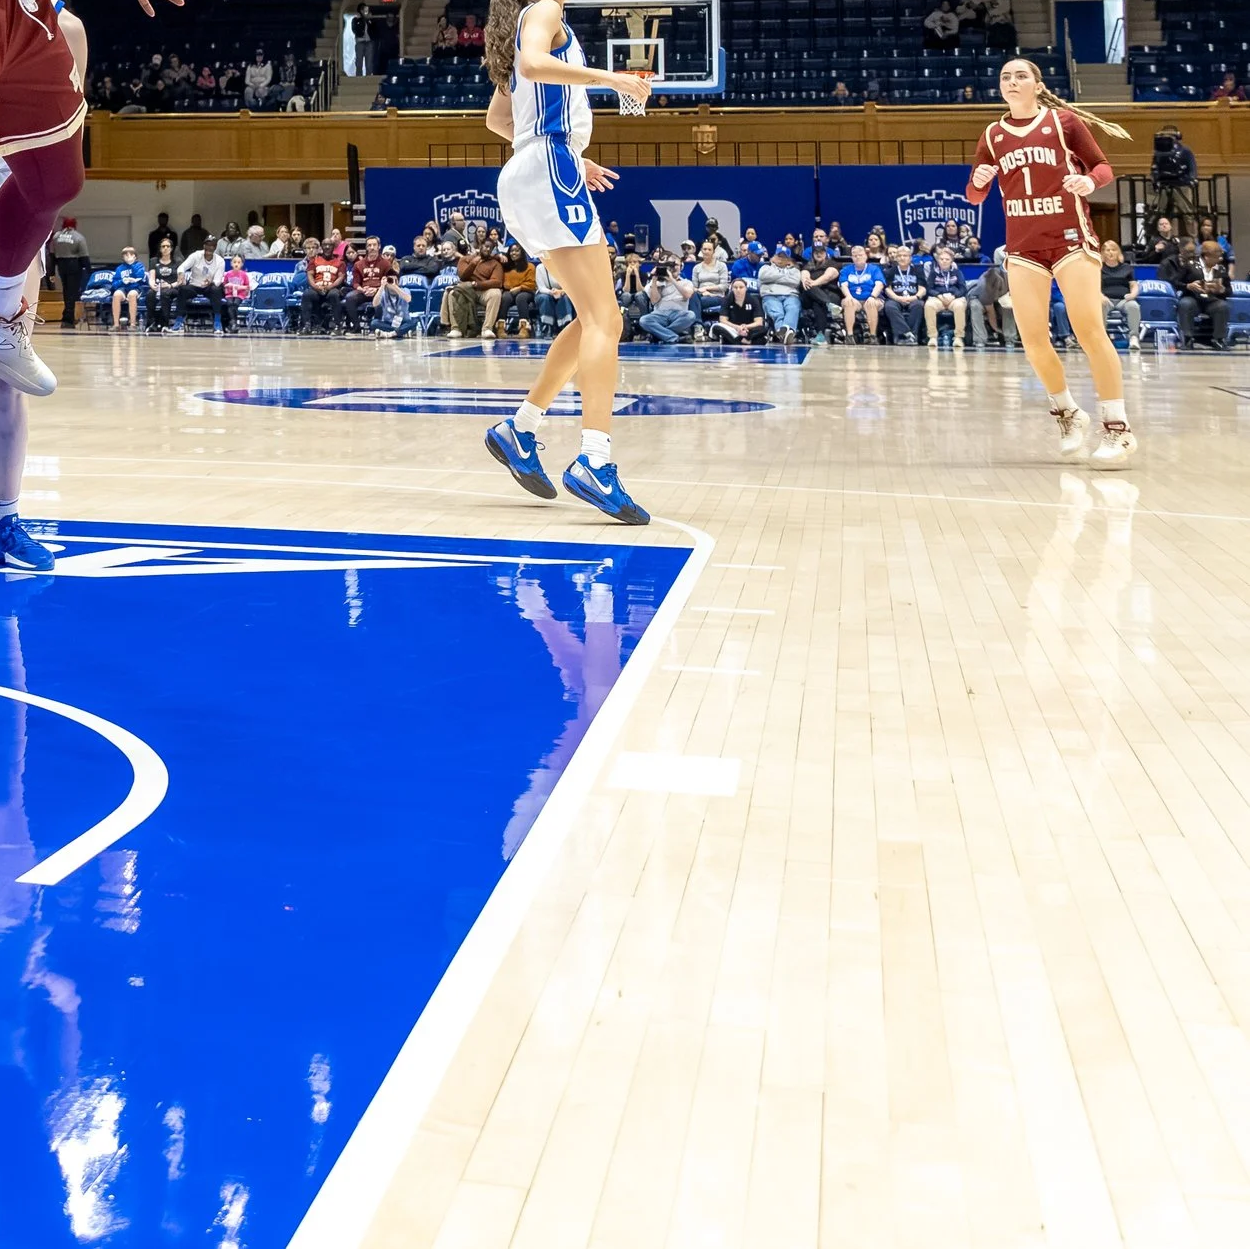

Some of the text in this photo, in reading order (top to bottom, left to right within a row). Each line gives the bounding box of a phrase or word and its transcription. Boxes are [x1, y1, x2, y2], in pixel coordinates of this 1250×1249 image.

[999, 146, 1057, 175] BOSTON
[1021, 166, 1033, 196] 1
[904, 206, 976, 226] SISTERHOOD
[1006, 195, 1065, 217] COLLEGE
[402, 274, 423, 286] DUKE
[1142, 282, 1167, 293] DUKE
